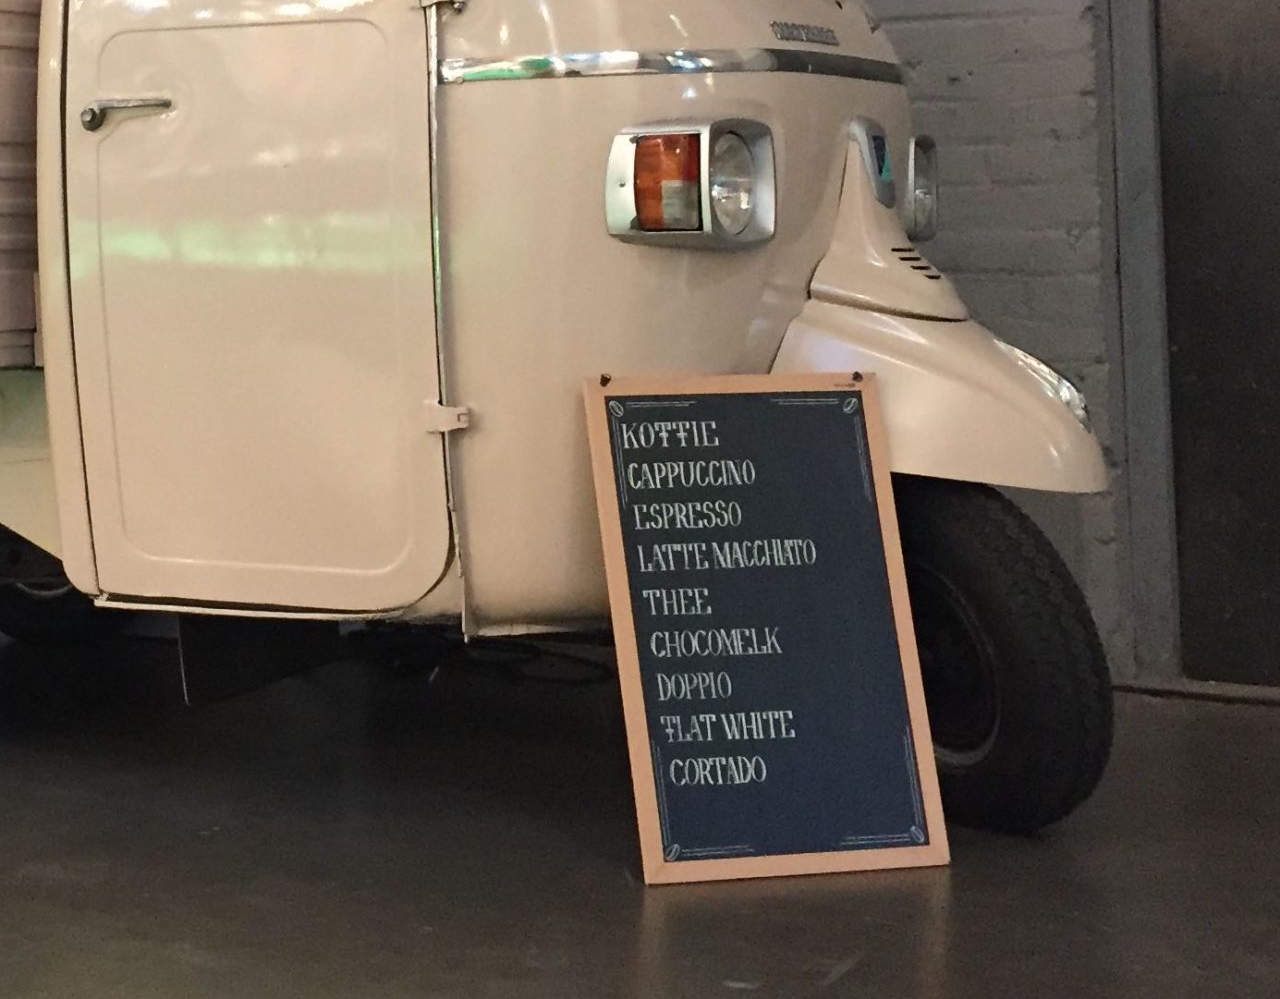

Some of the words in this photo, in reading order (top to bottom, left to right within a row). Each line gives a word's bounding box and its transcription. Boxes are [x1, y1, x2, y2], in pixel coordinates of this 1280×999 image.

[627, 459, 756, 490] CAPPUCCINO
[633, 500, 742, 530] ESPRESSO
[637, 542, 709, 573] LATTE
[711, 538, 817, 570] MACCHIATO
[642, 587, 712, 616] THEE
[650, 626, 783, 658] CHOCOMELK
[656, 671, 732, 701] DOPPIO
[720, 710, 796, 741] WHITE
[670, 755, 767, 786] CORTADO
